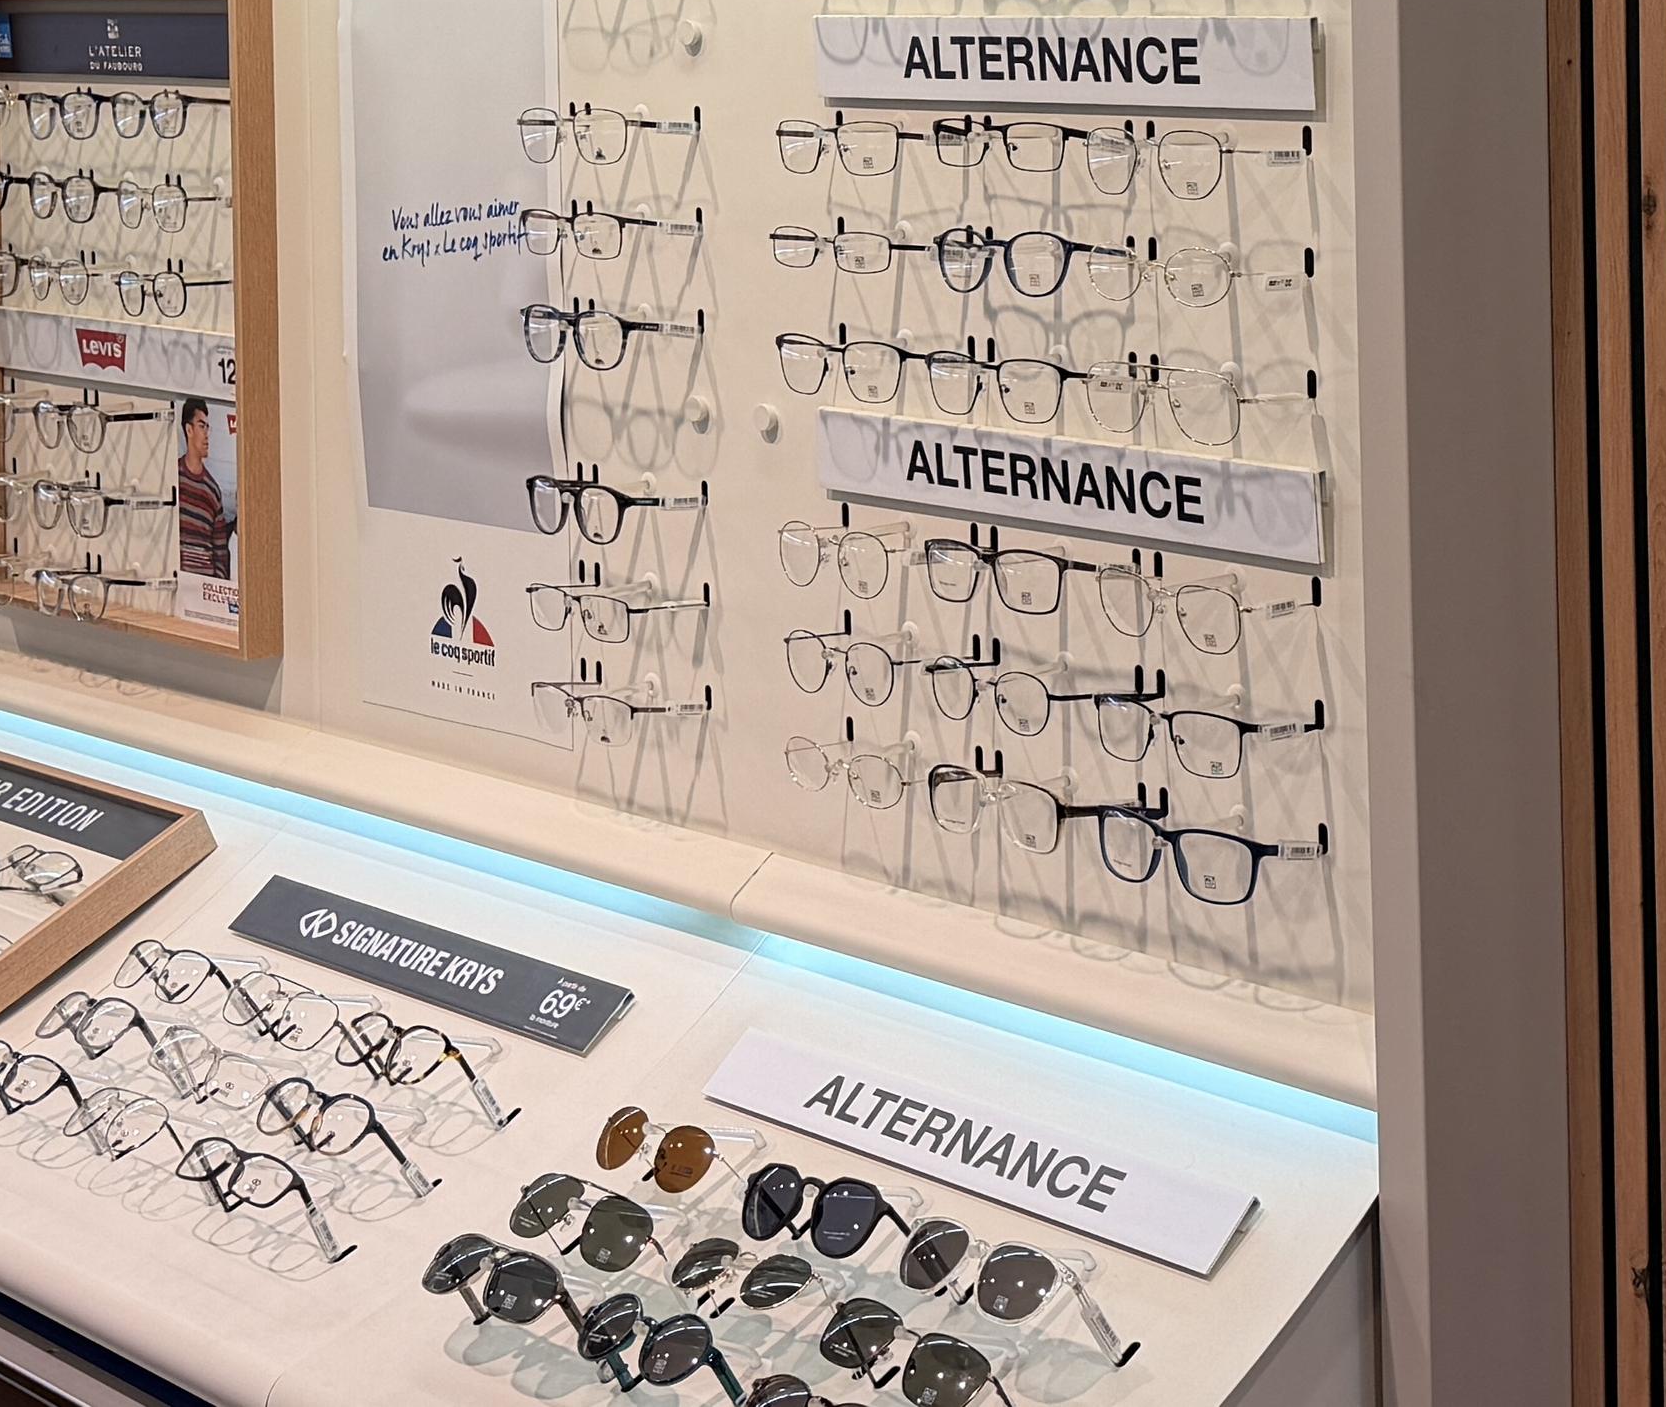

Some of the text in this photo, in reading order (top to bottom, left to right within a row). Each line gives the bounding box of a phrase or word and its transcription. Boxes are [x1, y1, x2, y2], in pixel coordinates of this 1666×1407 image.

[88, 45, 142, 58] L'ATELIER
[89, 60, 143, 72] DU FAUBOURG
[903, 35, 1201, 85] ALTERNANCE
[392, 198, 520, 231] Vous allez vous aimer
[383, 245, 399, 261] en
[401, 233, 430, 267] Krys
[460, 235, 483, 262] coq
[483, 220, 529, 255] sportif
[906, 439, 1206, 525] ALTERNANCE
[430, 637, 495, 667] le coq sportif
[6, 781, 107, 834] EDITION
[332, 919, 505, 996] SIGNATURE KRYS
[802, 1074, 1128, 1214] ALTERNANCE
